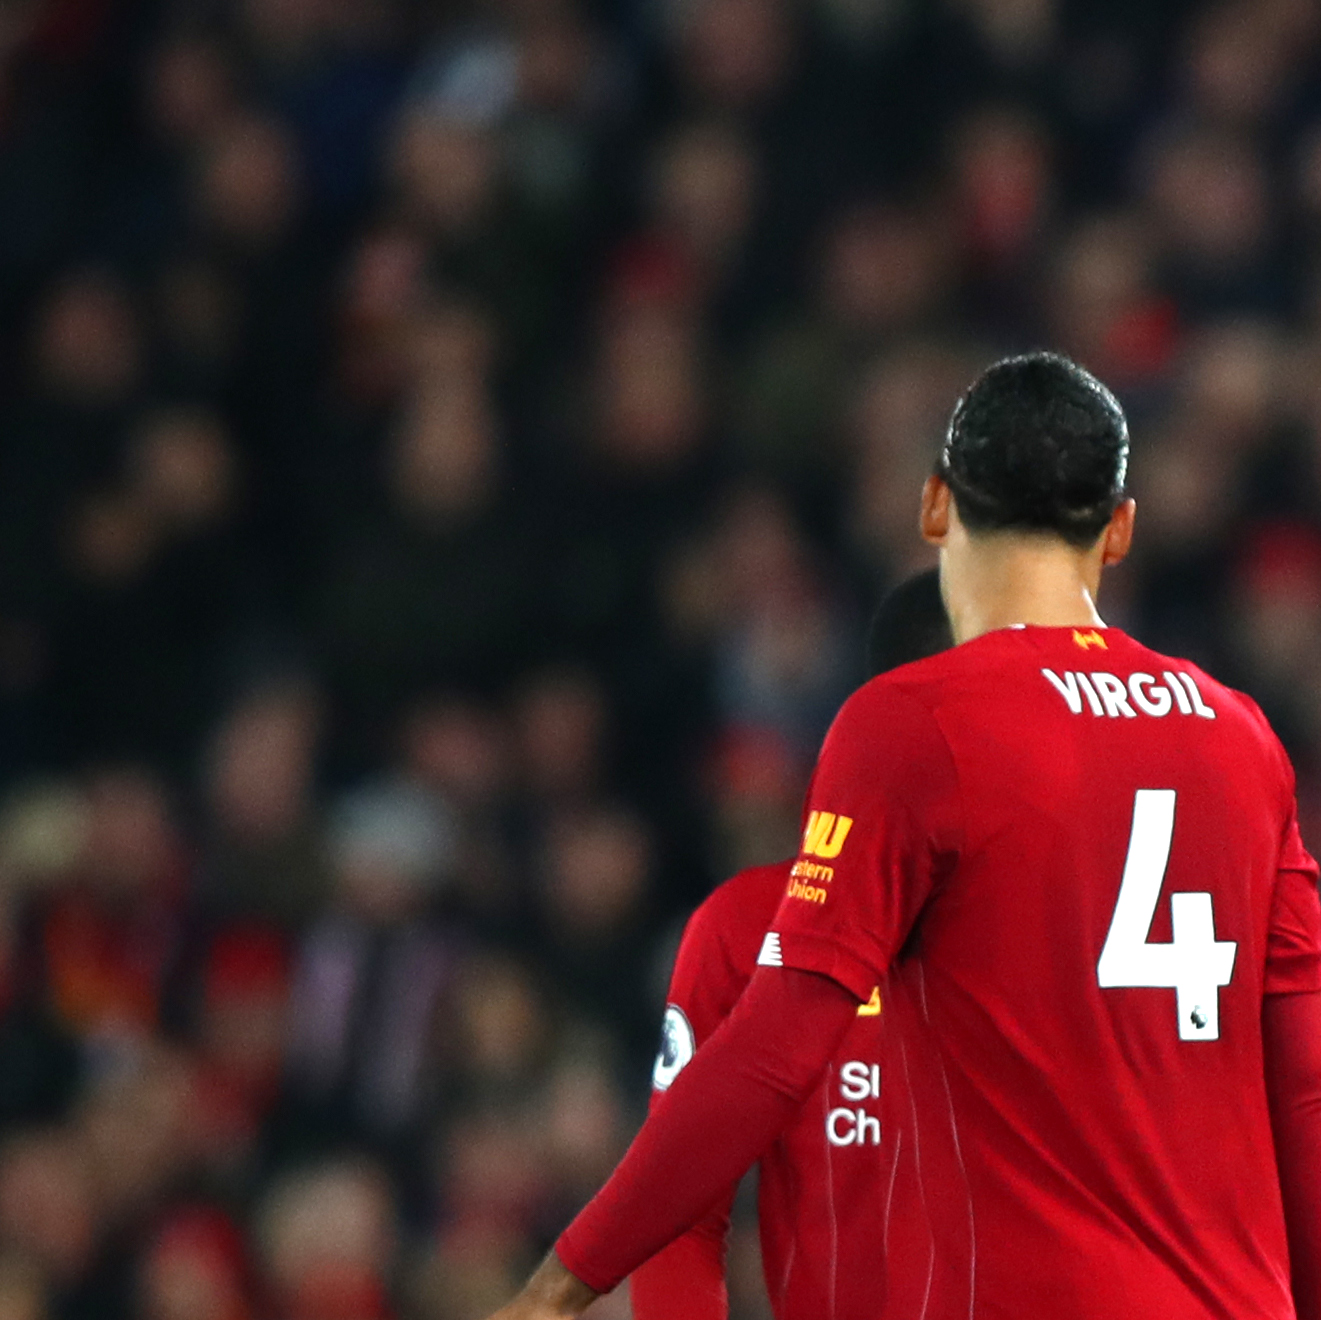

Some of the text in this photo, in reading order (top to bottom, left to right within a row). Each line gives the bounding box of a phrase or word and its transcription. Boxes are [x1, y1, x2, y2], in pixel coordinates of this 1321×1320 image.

[1041, 668, 1216, 719] VIRGIL
[790, 860, 834, 882] estern
[1097, 789, 1237, 1041] 4
